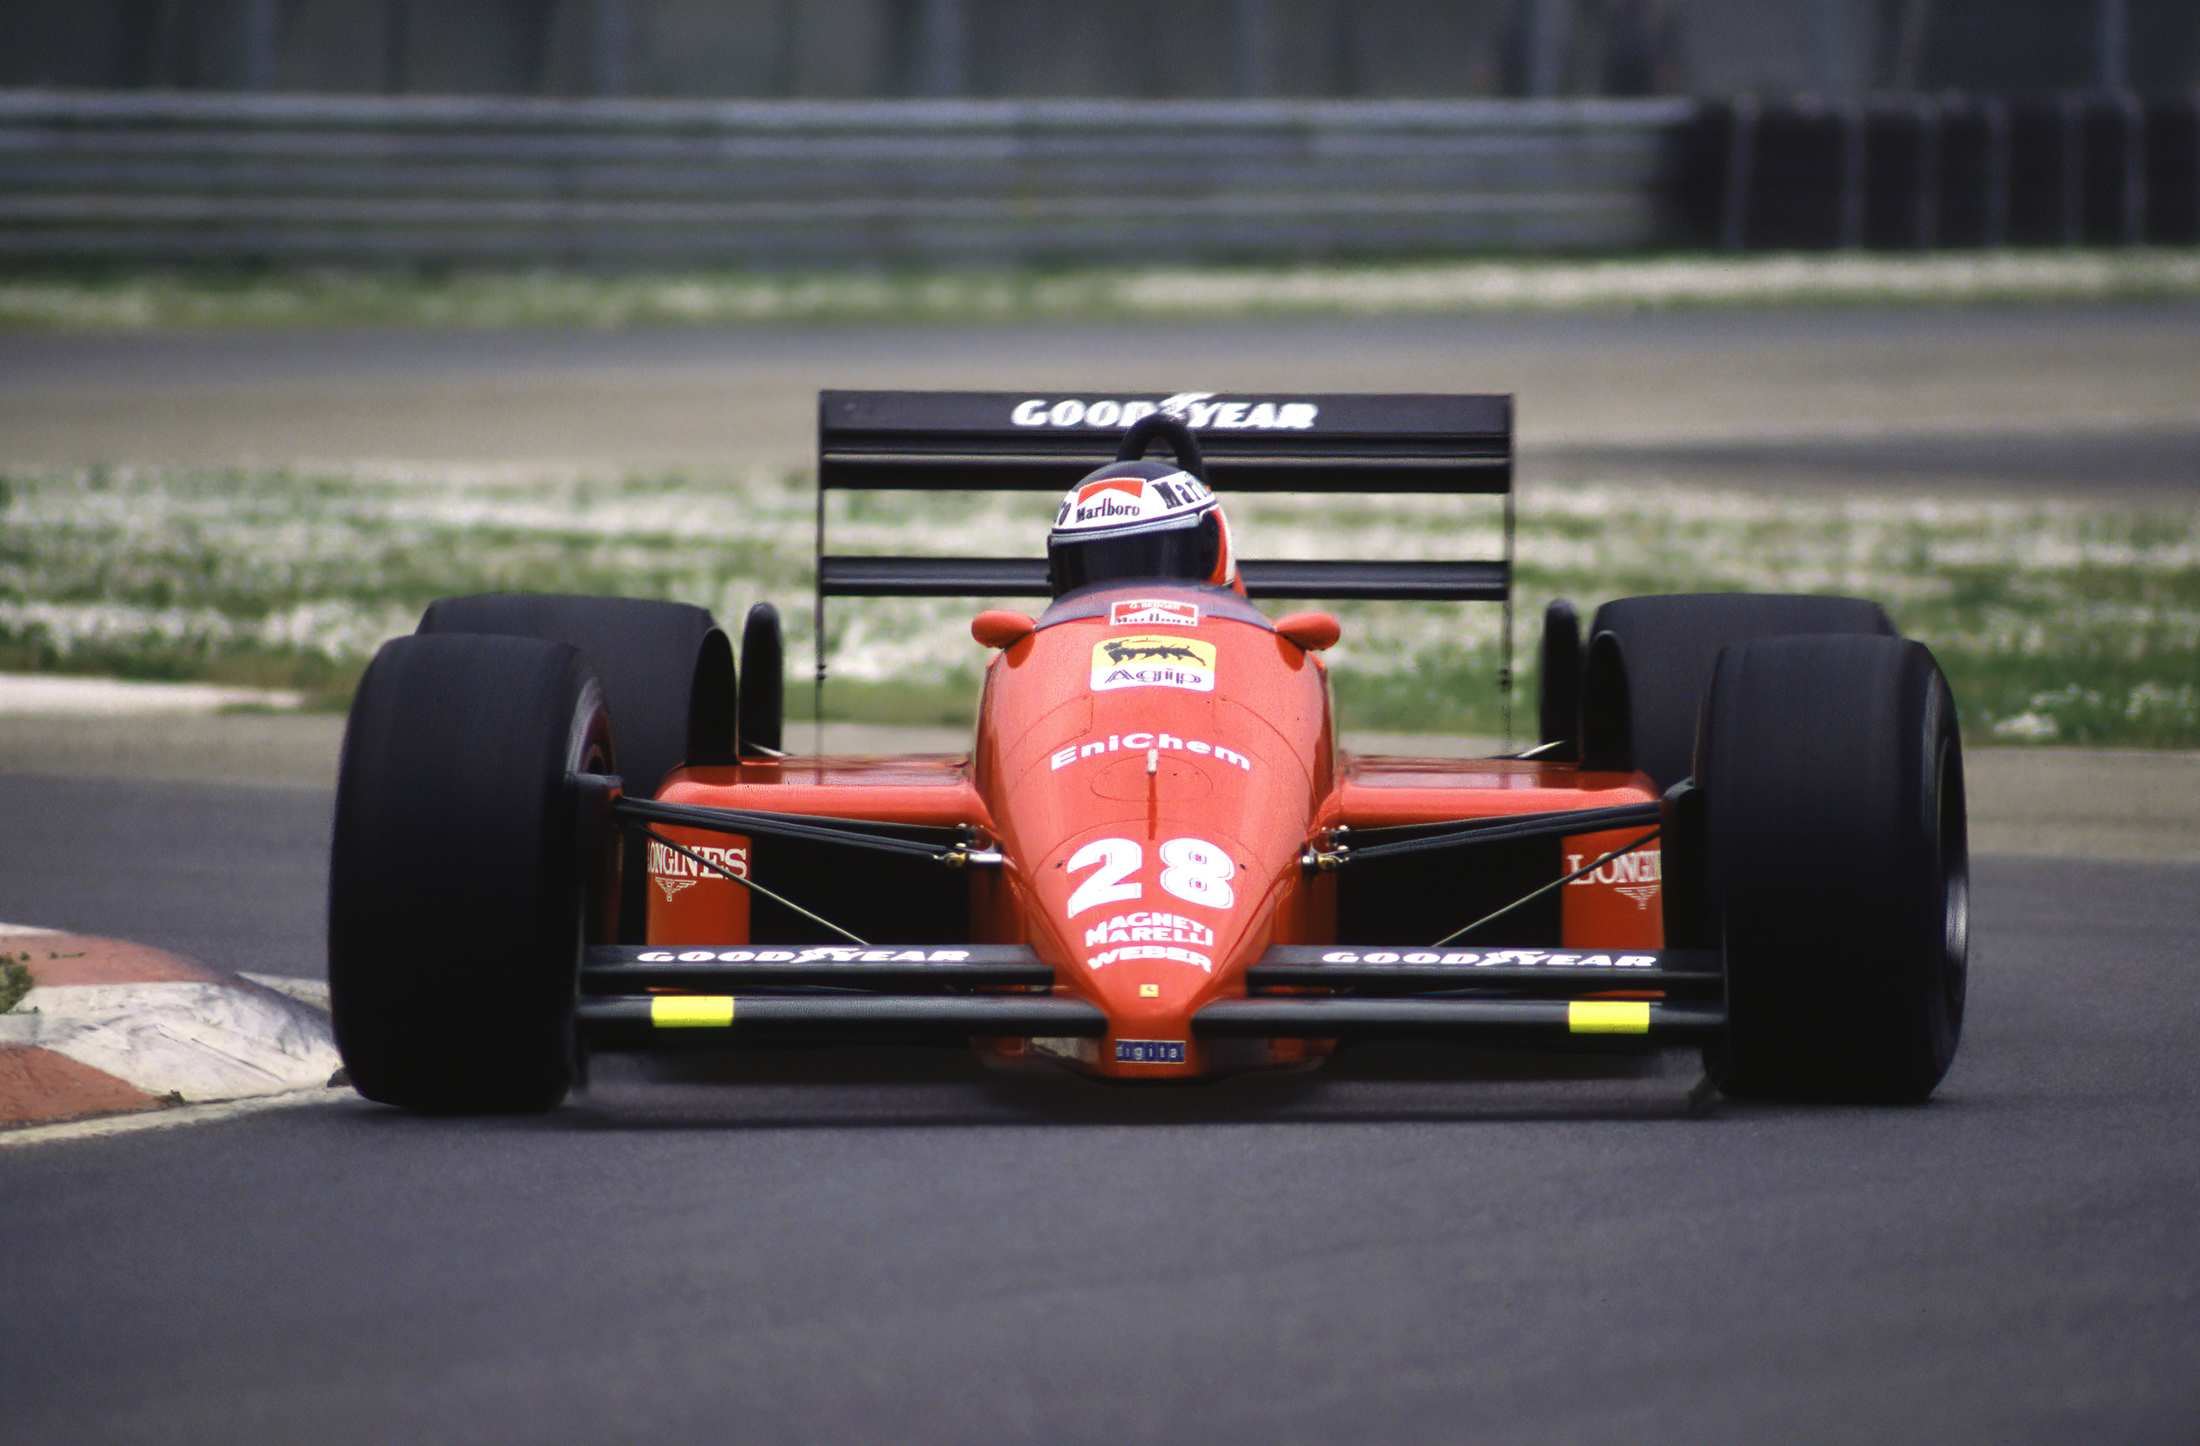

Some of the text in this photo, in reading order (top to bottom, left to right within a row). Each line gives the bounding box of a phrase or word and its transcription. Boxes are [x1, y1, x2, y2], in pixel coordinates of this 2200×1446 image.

[1011, 392, 1319, 429] GOODYEAR
[1075, 497, 1140, 524] Marlboro
[1104, 668, 1202, 684] Agip
[1051, 733, 1250, 771] EniChem
[647, 841, 748, 880] ONGINES
[1066, 837, 1235, 919] 28
[1085, 912, 1213, 947] MAGNETI
[1085, 923, 1213, 947] MARELLI
[637, 947, 970, 964] GOODYEAR
[1087, 945, 1212, 973] WEBER
[1322, 951, 1657, 967] GOODYEAR
